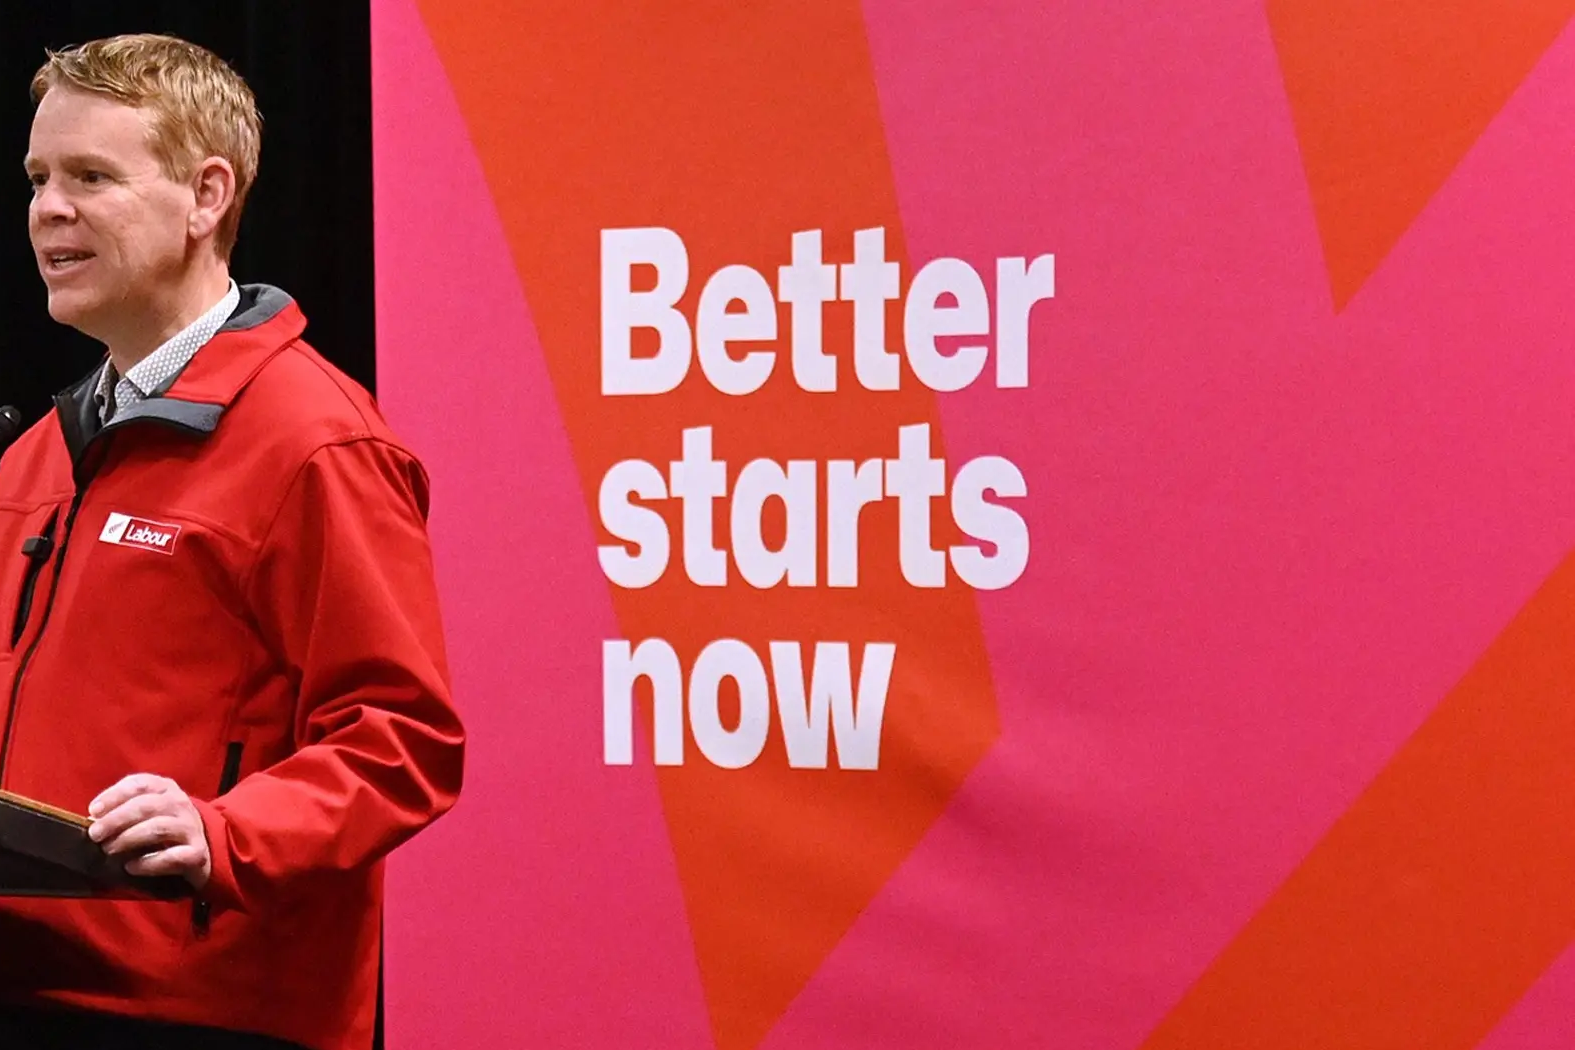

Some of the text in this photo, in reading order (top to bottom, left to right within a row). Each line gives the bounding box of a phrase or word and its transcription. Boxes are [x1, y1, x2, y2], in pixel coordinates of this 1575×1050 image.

[600, 226, 1055, 396] Better
[125, 523, 172, 547] Labour
[597, 423, 1030, 590] starts
[602, 637, 897, 770] now
